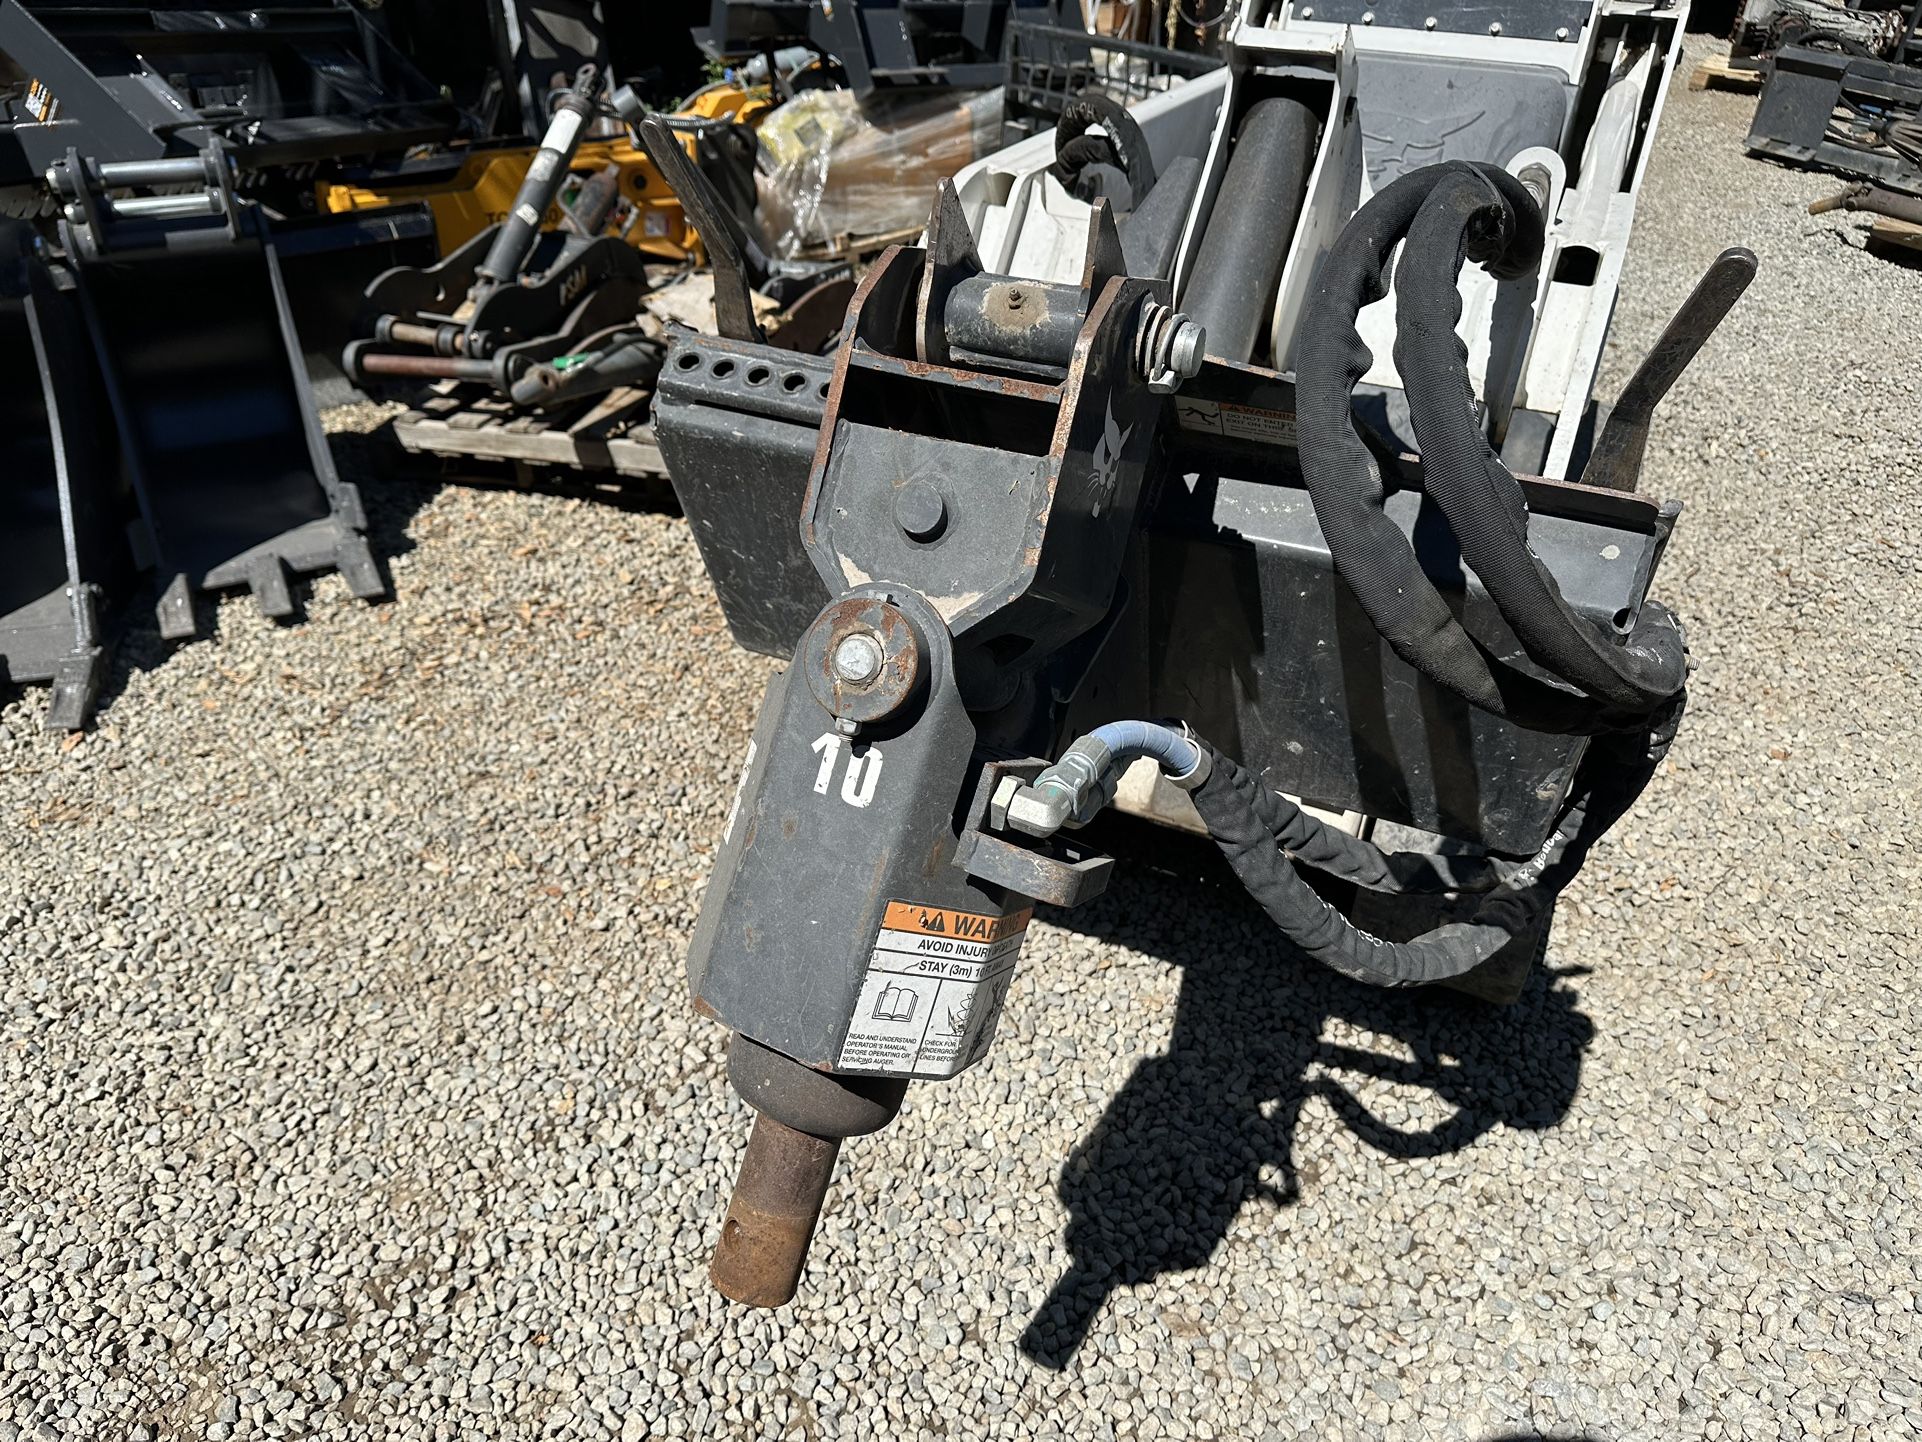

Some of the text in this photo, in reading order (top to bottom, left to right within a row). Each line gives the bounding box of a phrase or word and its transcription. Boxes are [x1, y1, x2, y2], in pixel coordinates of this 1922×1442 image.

[1244, 406, 1297, 419] WARNIN
[811, 732, 883, 808] 10
[918, 939, 953, 953] AVOID
[955, 944, 991, 958] INJURY
[919, 960, 948, 973] STAY
[949, 963, 973, 978] (3m)
[865, 1034, 878, 1042] AND
[879, 1036, 917, 1044] UNDERSTAND
[841, 1056, 873, 1064] SERVICING
